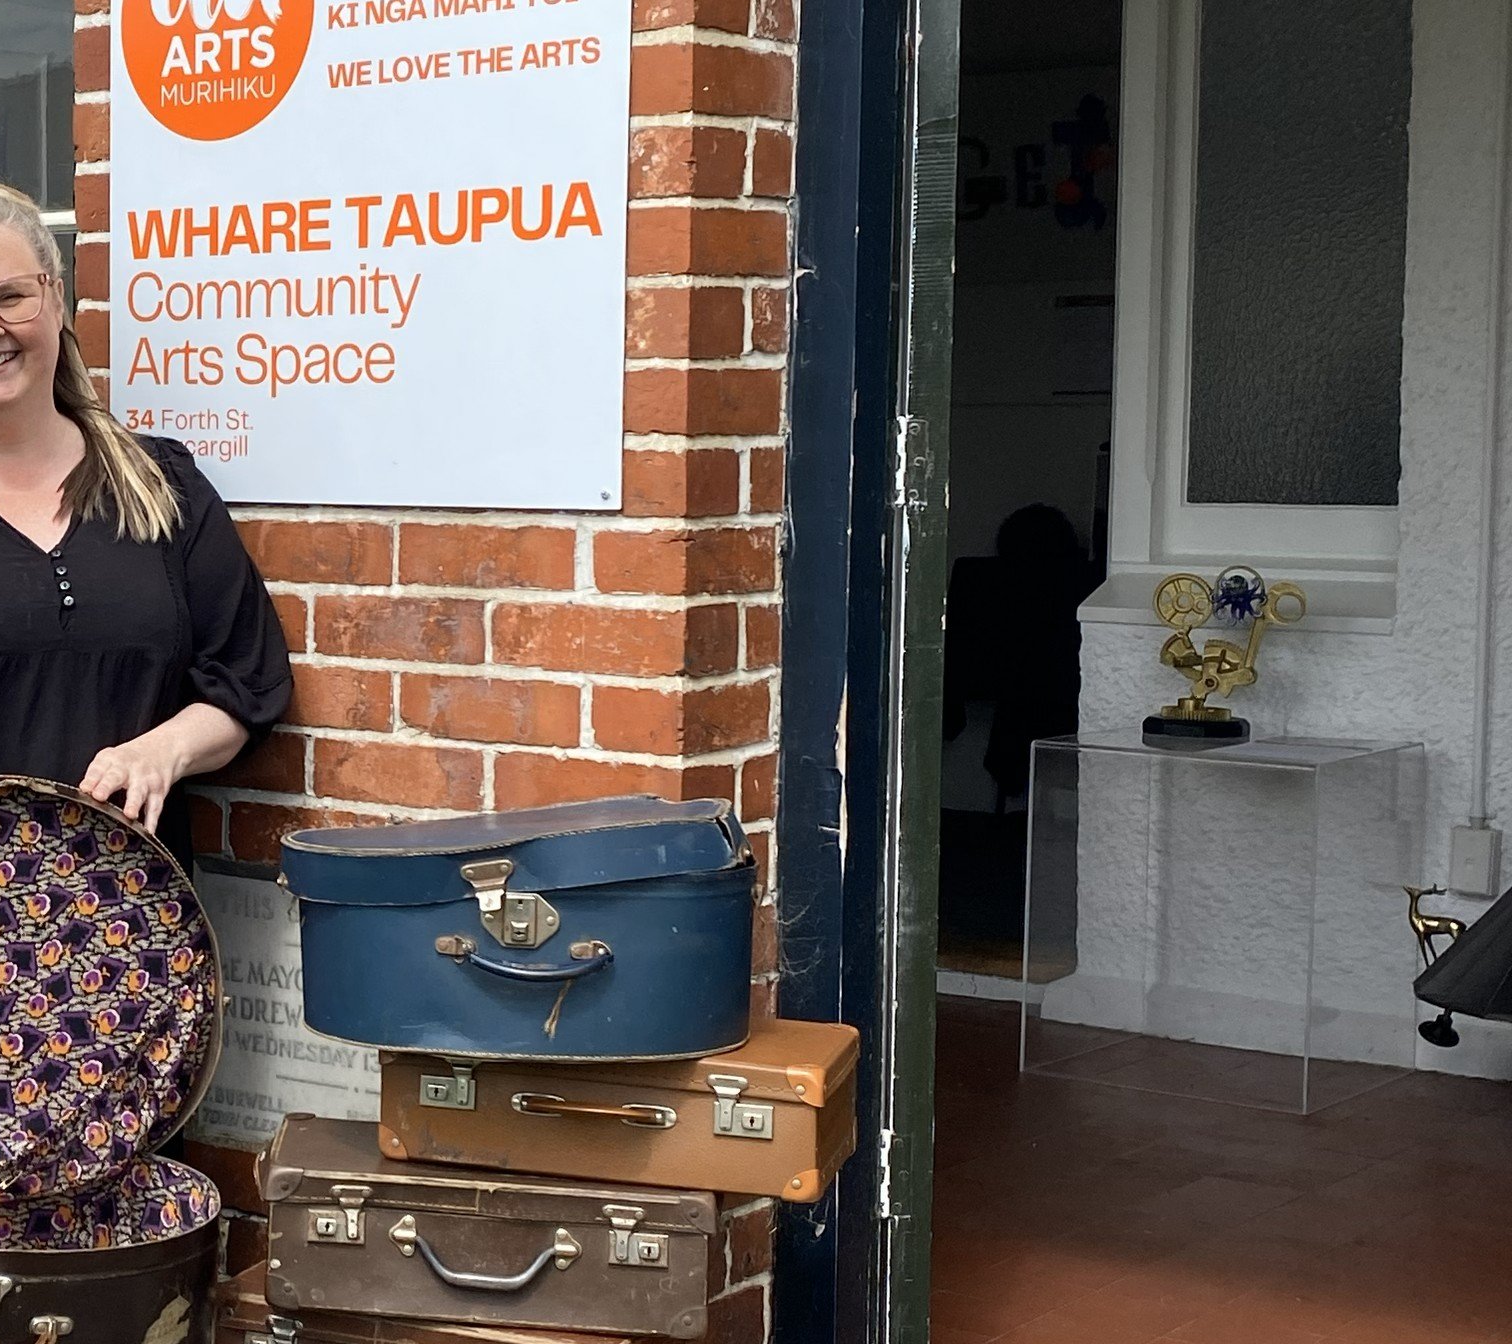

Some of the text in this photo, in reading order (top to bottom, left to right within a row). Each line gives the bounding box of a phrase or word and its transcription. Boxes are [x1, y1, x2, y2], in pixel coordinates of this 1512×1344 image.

[327, 2, 359, 30] KI
[160, 25, 276, 78] ARTS
[327, 36, 601, 89] WE LOVE THE ARTS
[160, 74, 276, 107] MURIHIKU
[126, 181, 604, 260] WHARE TAUPUA
[126, 262, 422, 329] Community
[126, 332, 397, 399] Arts Space
[126, 408, 255, 431] 34 Forth St.
[182, 435, 248, 462] cargill
